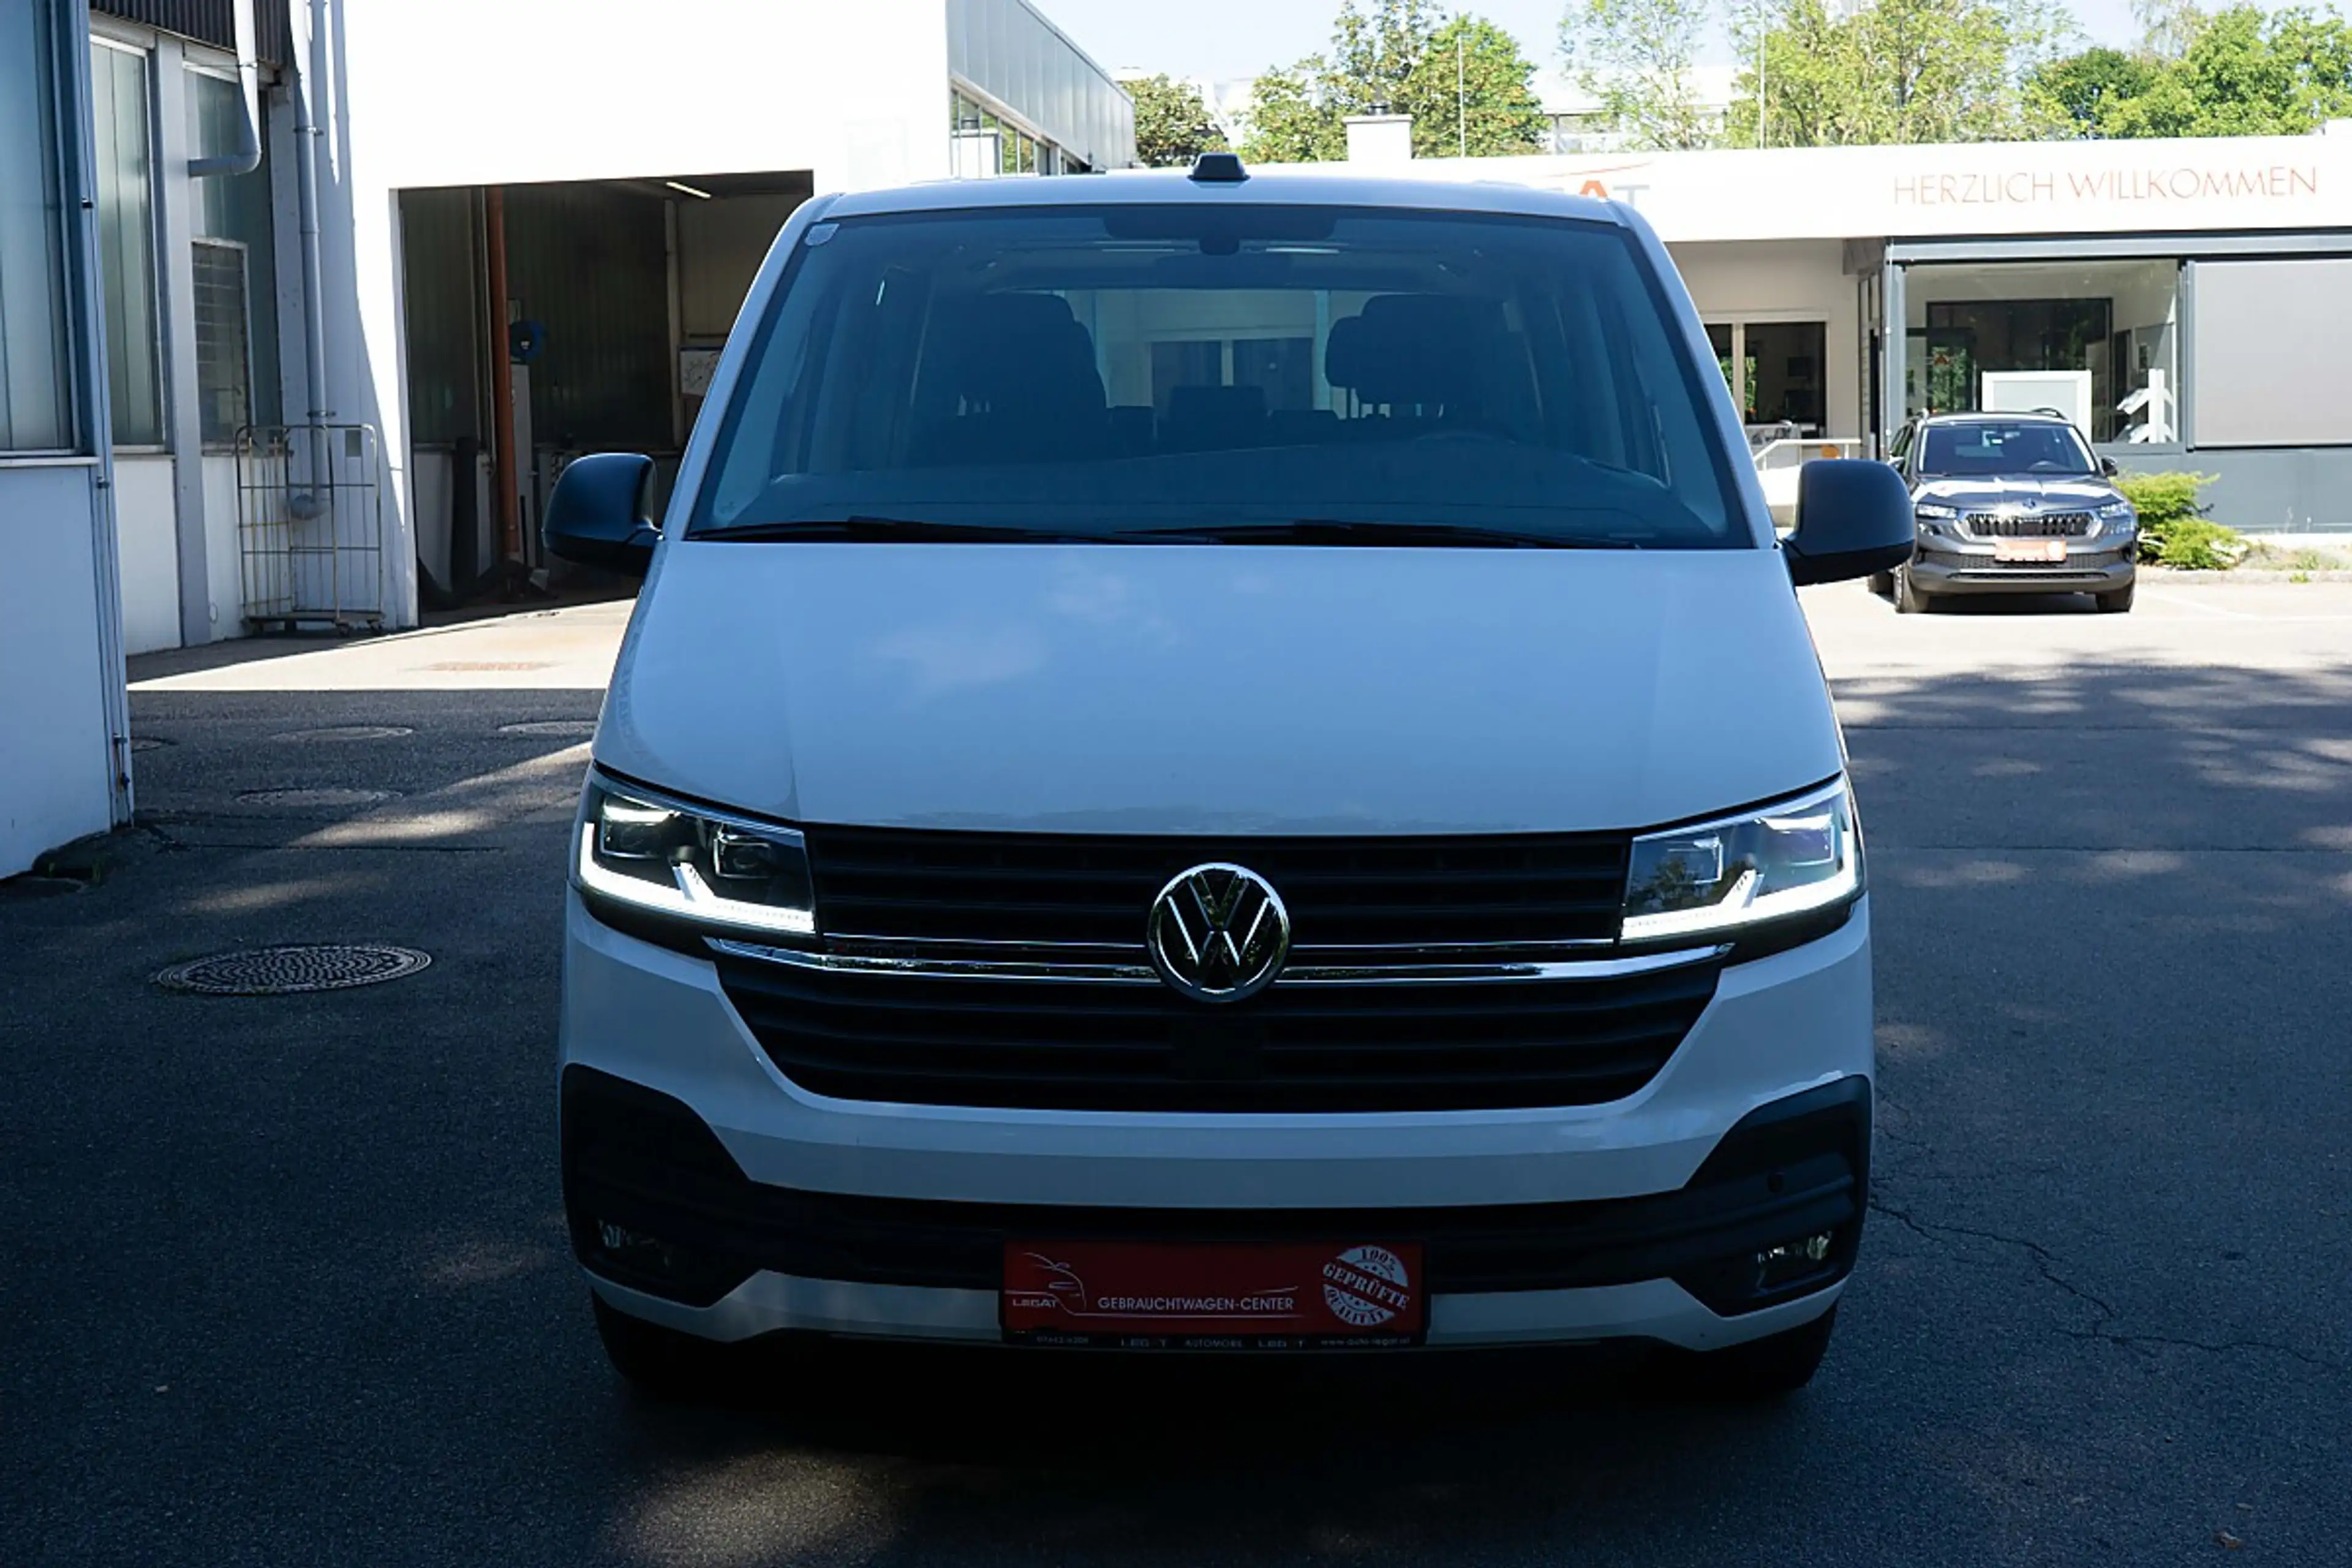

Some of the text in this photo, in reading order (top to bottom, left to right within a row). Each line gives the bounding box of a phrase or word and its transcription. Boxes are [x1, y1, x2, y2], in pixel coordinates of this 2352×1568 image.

[1894, 167, 2320, 205] HERZLICH WILLKOMMEN
[1322, 1262, 1411, 1312] GEPRÜFTE
[1011, 1298, 1059, 1308] LEGAT
[1098, 1295, 1295, 1312] GEBRAUCHTWAGEN-CENTER
